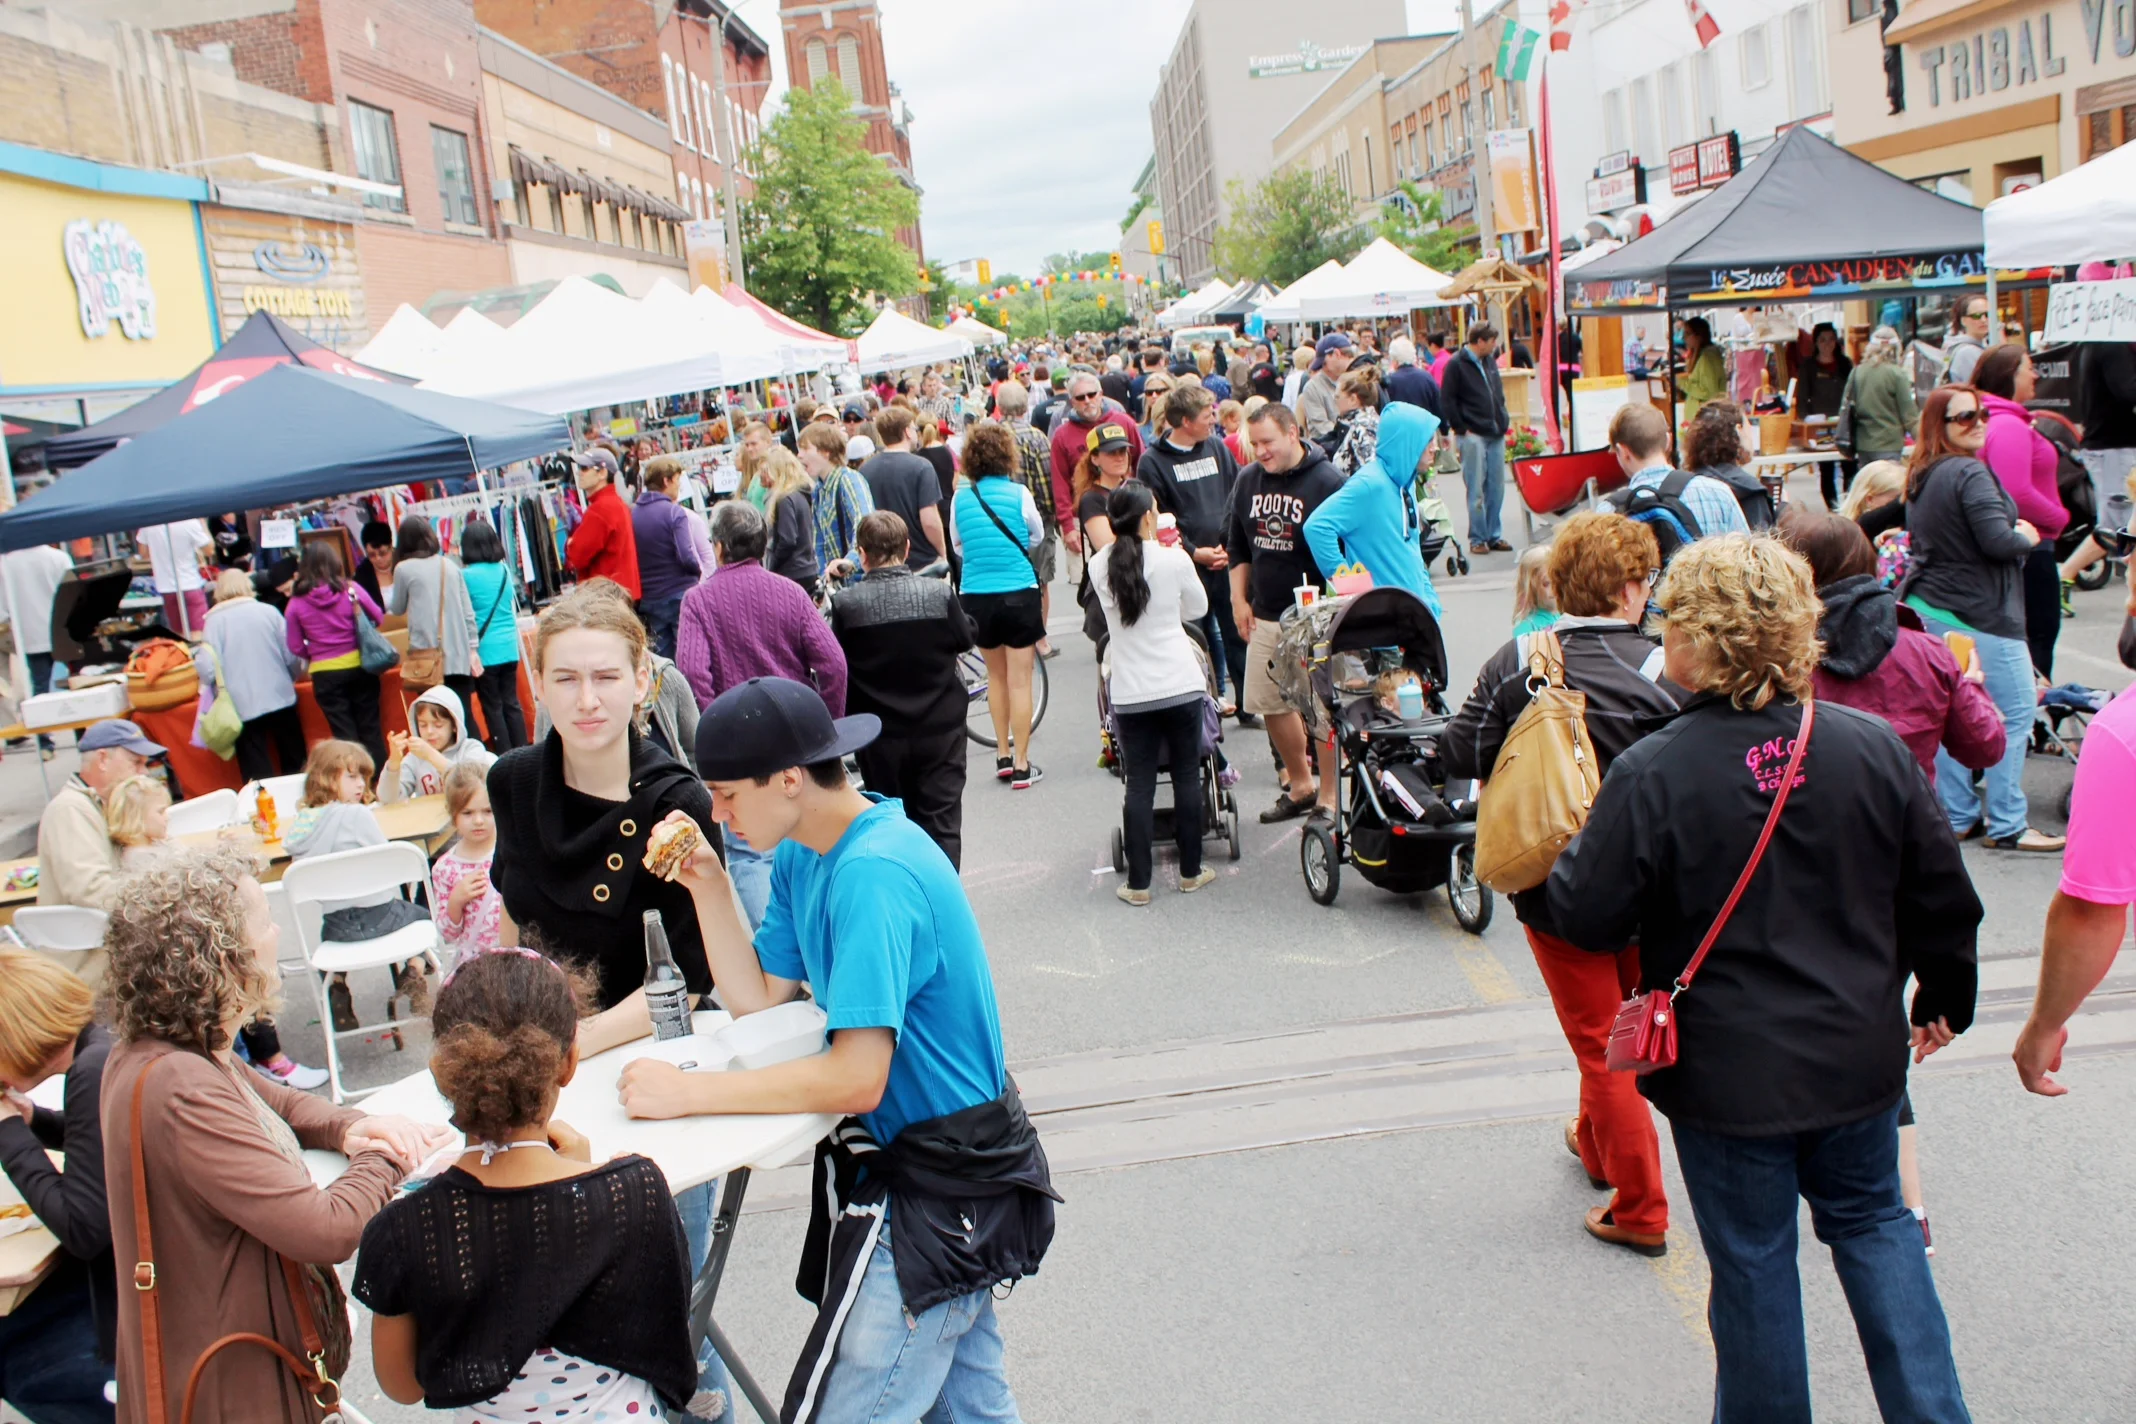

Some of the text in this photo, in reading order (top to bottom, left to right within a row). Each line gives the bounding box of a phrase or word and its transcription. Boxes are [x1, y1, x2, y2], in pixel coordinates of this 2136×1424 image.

[1248, 52, 1304, 69] Empress
[1920, 12, 2065, 107] TRIBAL
[1699, 142, 1731, 178] HOTEL
[1786, 257, 1915, 284] CANADIEN
[243, 285, 352, 318] COTTAGE TOYS
[1249, 493, 1304, 524] ROOTS
[1253, 535, 1294, 551] ATHLETICS
